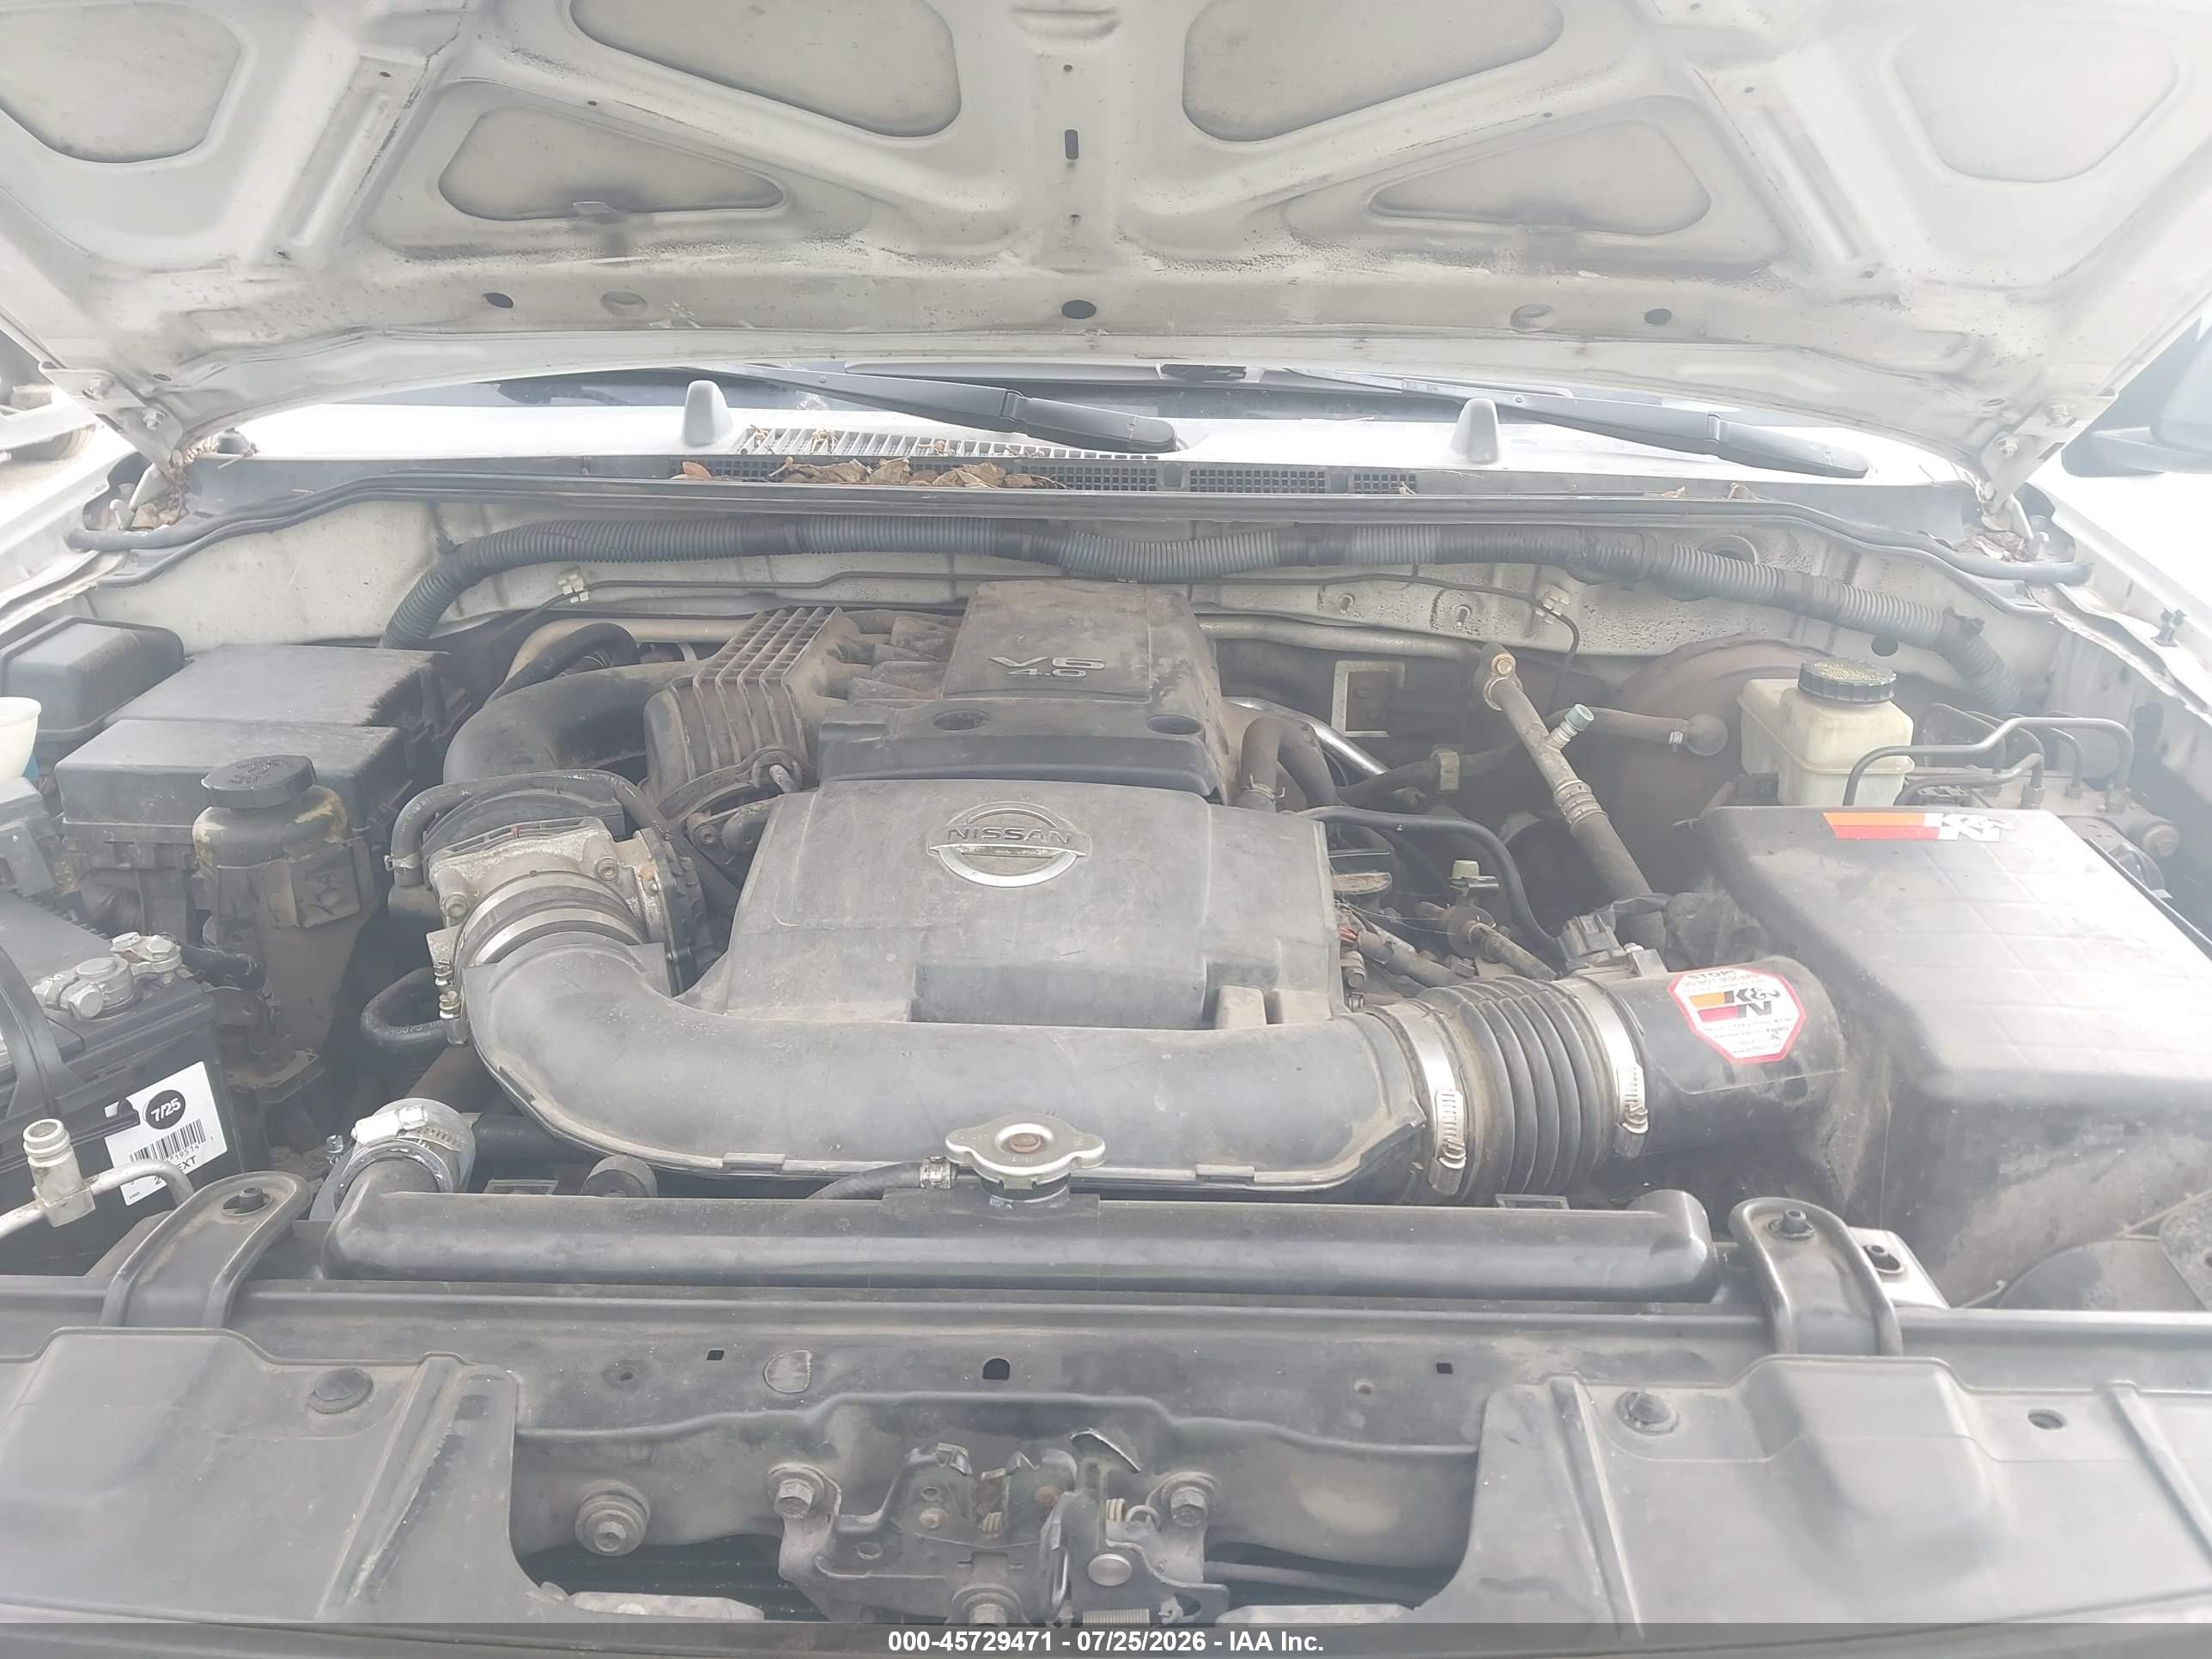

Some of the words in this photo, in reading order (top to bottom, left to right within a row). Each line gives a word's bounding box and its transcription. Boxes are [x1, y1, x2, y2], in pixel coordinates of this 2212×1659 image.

[988, 656, 1105, 670] V6
[1006, 668, 1087, 678] 4.0
[947, 827, 1073, 845] NISSAN
[150, 1097, 181, 1122] 7/25
